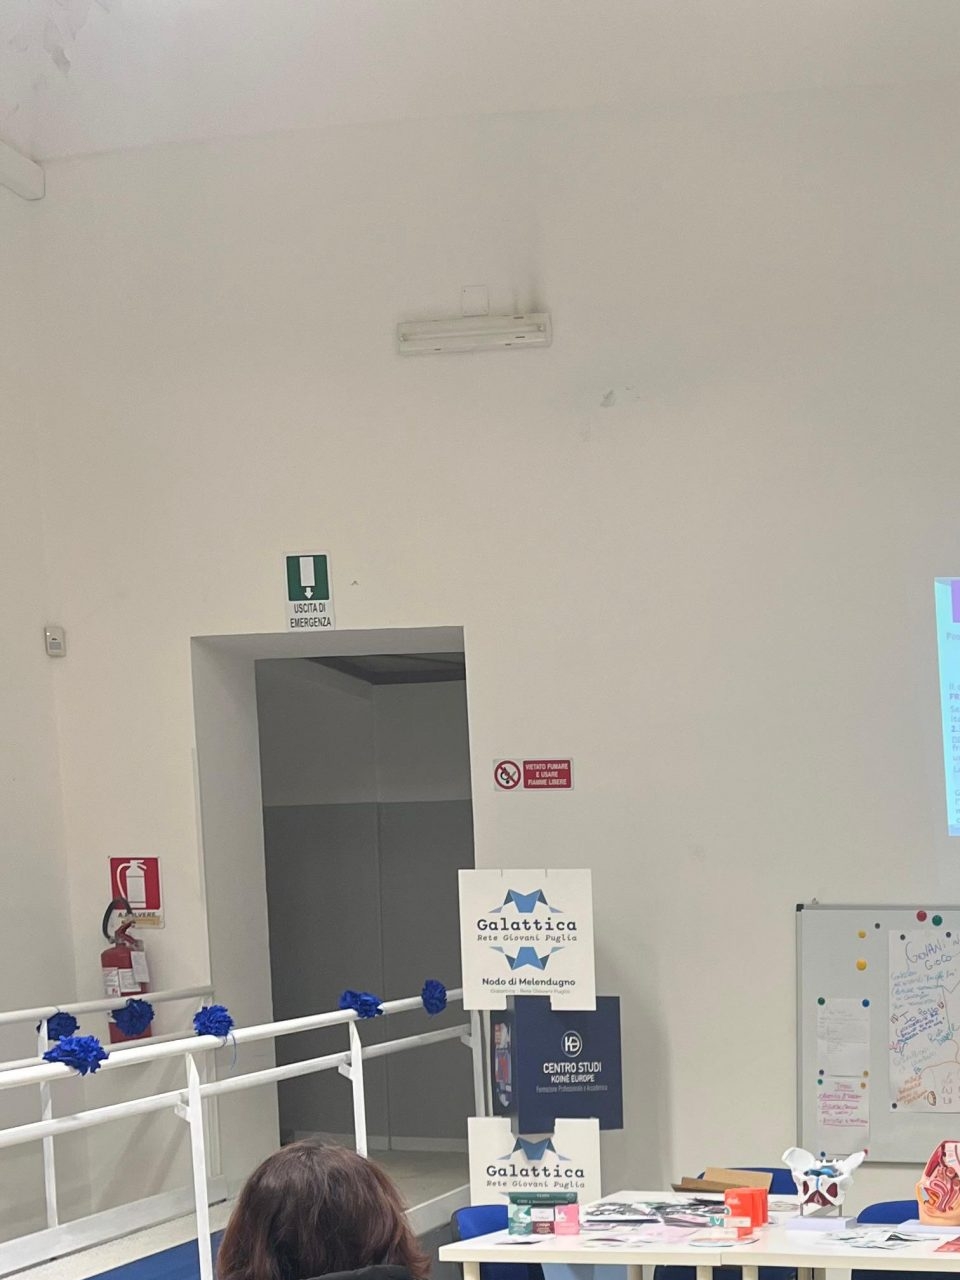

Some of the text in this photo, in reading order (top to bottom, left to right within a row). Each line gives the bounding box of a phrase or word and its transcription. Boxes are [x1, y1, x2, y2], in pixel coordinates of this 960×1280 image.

[294, 602, 326, 613] USCITA DI
[290, 617, 331, 628] EMERGENZA
[477, 917, 577, 931] Galattica
[477, 933, 577, 943] Rete Giovani Puglia
[482, 977, 576, 988] Nodo di Melendugno
[543, 1061, 602, 1073] CENTRO STUDI
[571, 1074, 595, 1083] EUROPE
[486, 1164, 584, 1178] Galattica
[553, 1180, 585, 1189] Puglia
